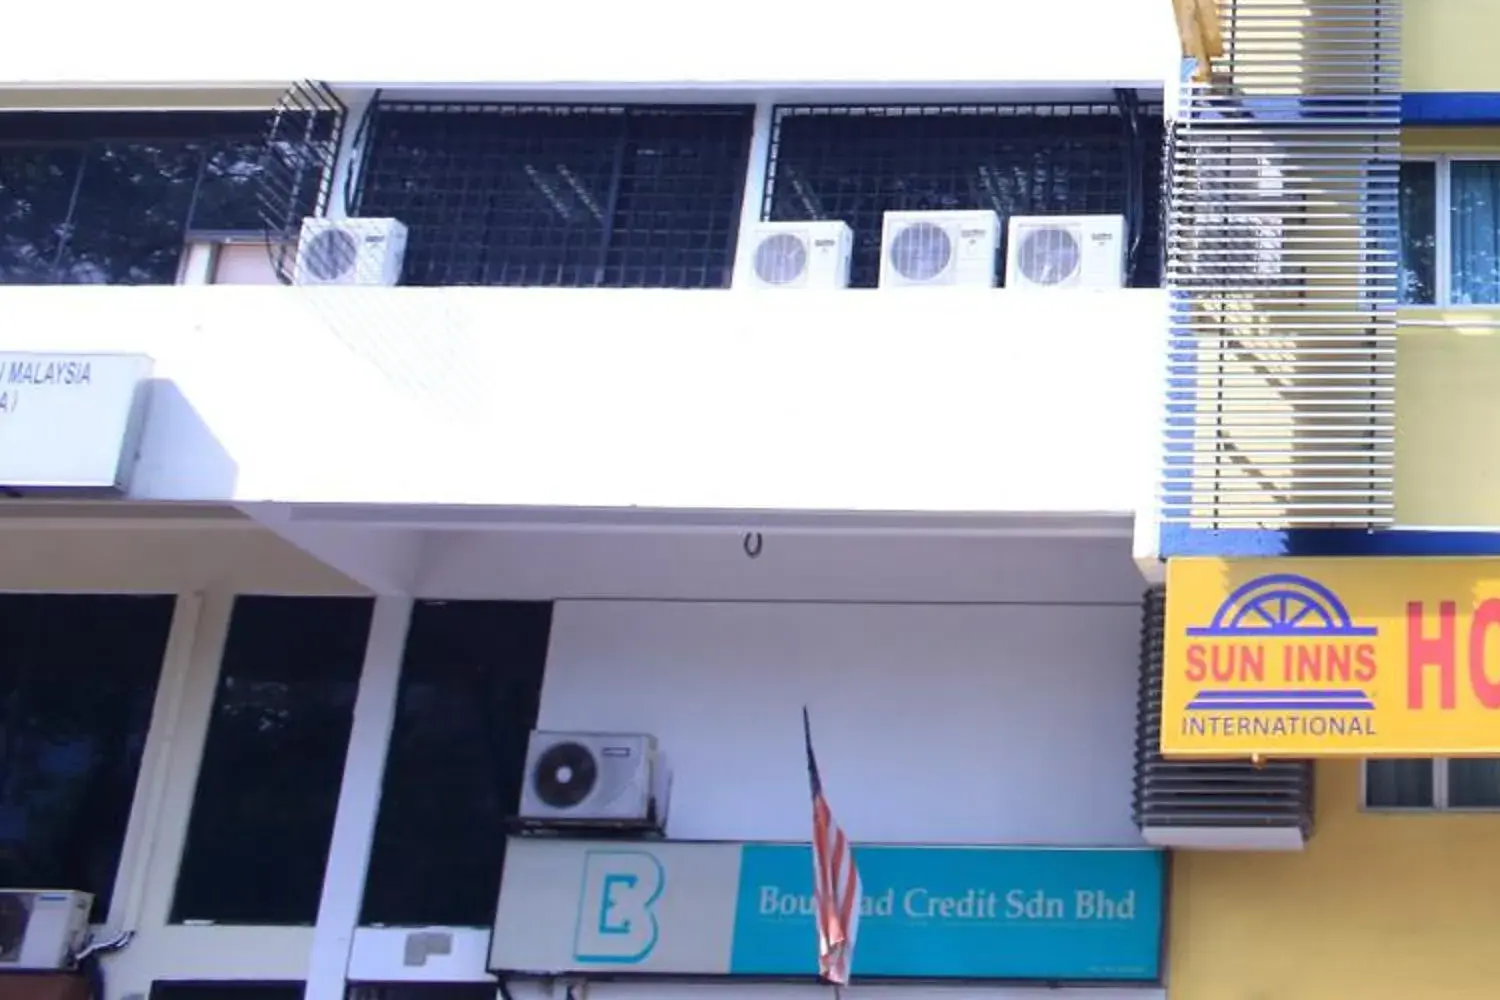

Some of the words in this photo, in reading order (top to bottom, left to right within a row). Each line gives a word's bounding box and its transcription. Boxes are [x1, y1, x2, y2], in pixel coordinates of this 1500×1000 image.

[8, 360, 91, 385] MALAYSIA
[1184, 643, 1265, 684] SUN
[1283, 643, 1378, 684] INNS
[1182, 715, 1377, 737] INTERNATIONAL
[903, 888, 997, 919] Credit
[1004, 889, 1064, 919] Sdn
[1075, 890, 1136, 920] Bhd
